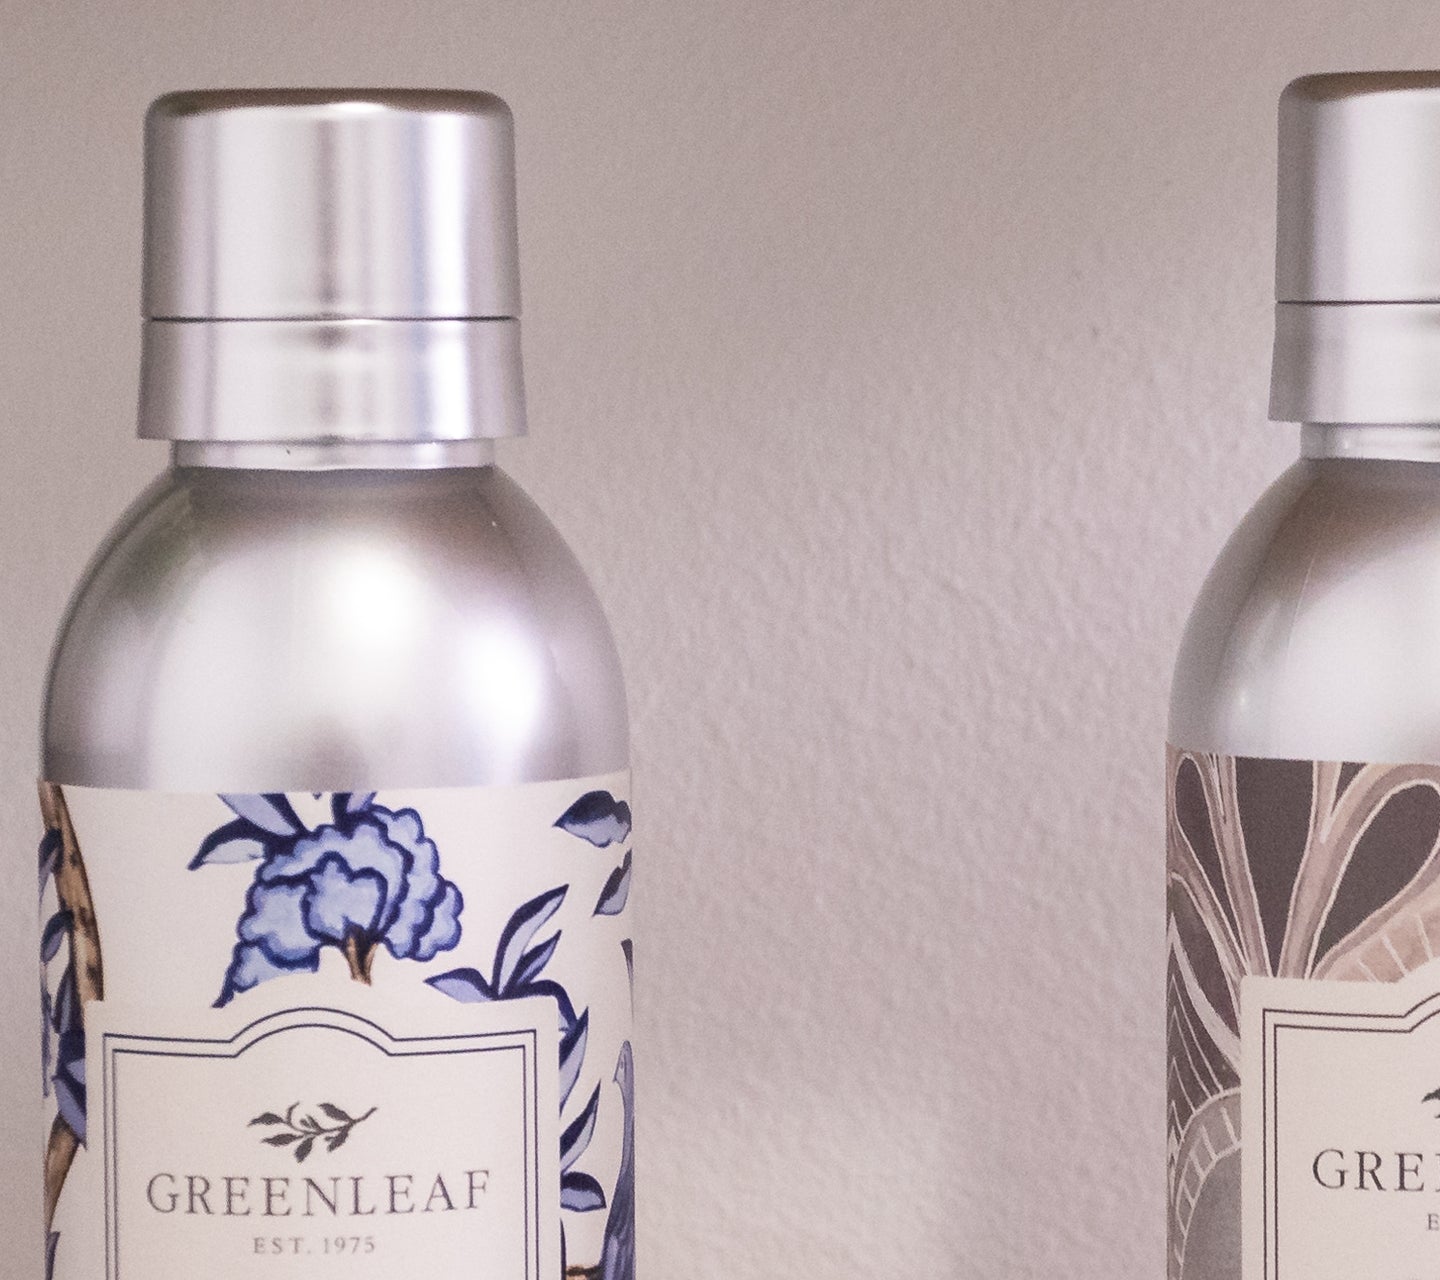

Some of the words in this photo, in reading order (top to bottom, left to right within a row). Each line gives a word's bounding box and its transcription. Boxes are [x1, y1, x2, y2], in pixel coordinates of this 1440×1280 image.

[145, 1169, 490, 1217] GREENLEAF
[252, 1236, 311, 1255] EST.
[323, 1235, 376, 1255] 1975
